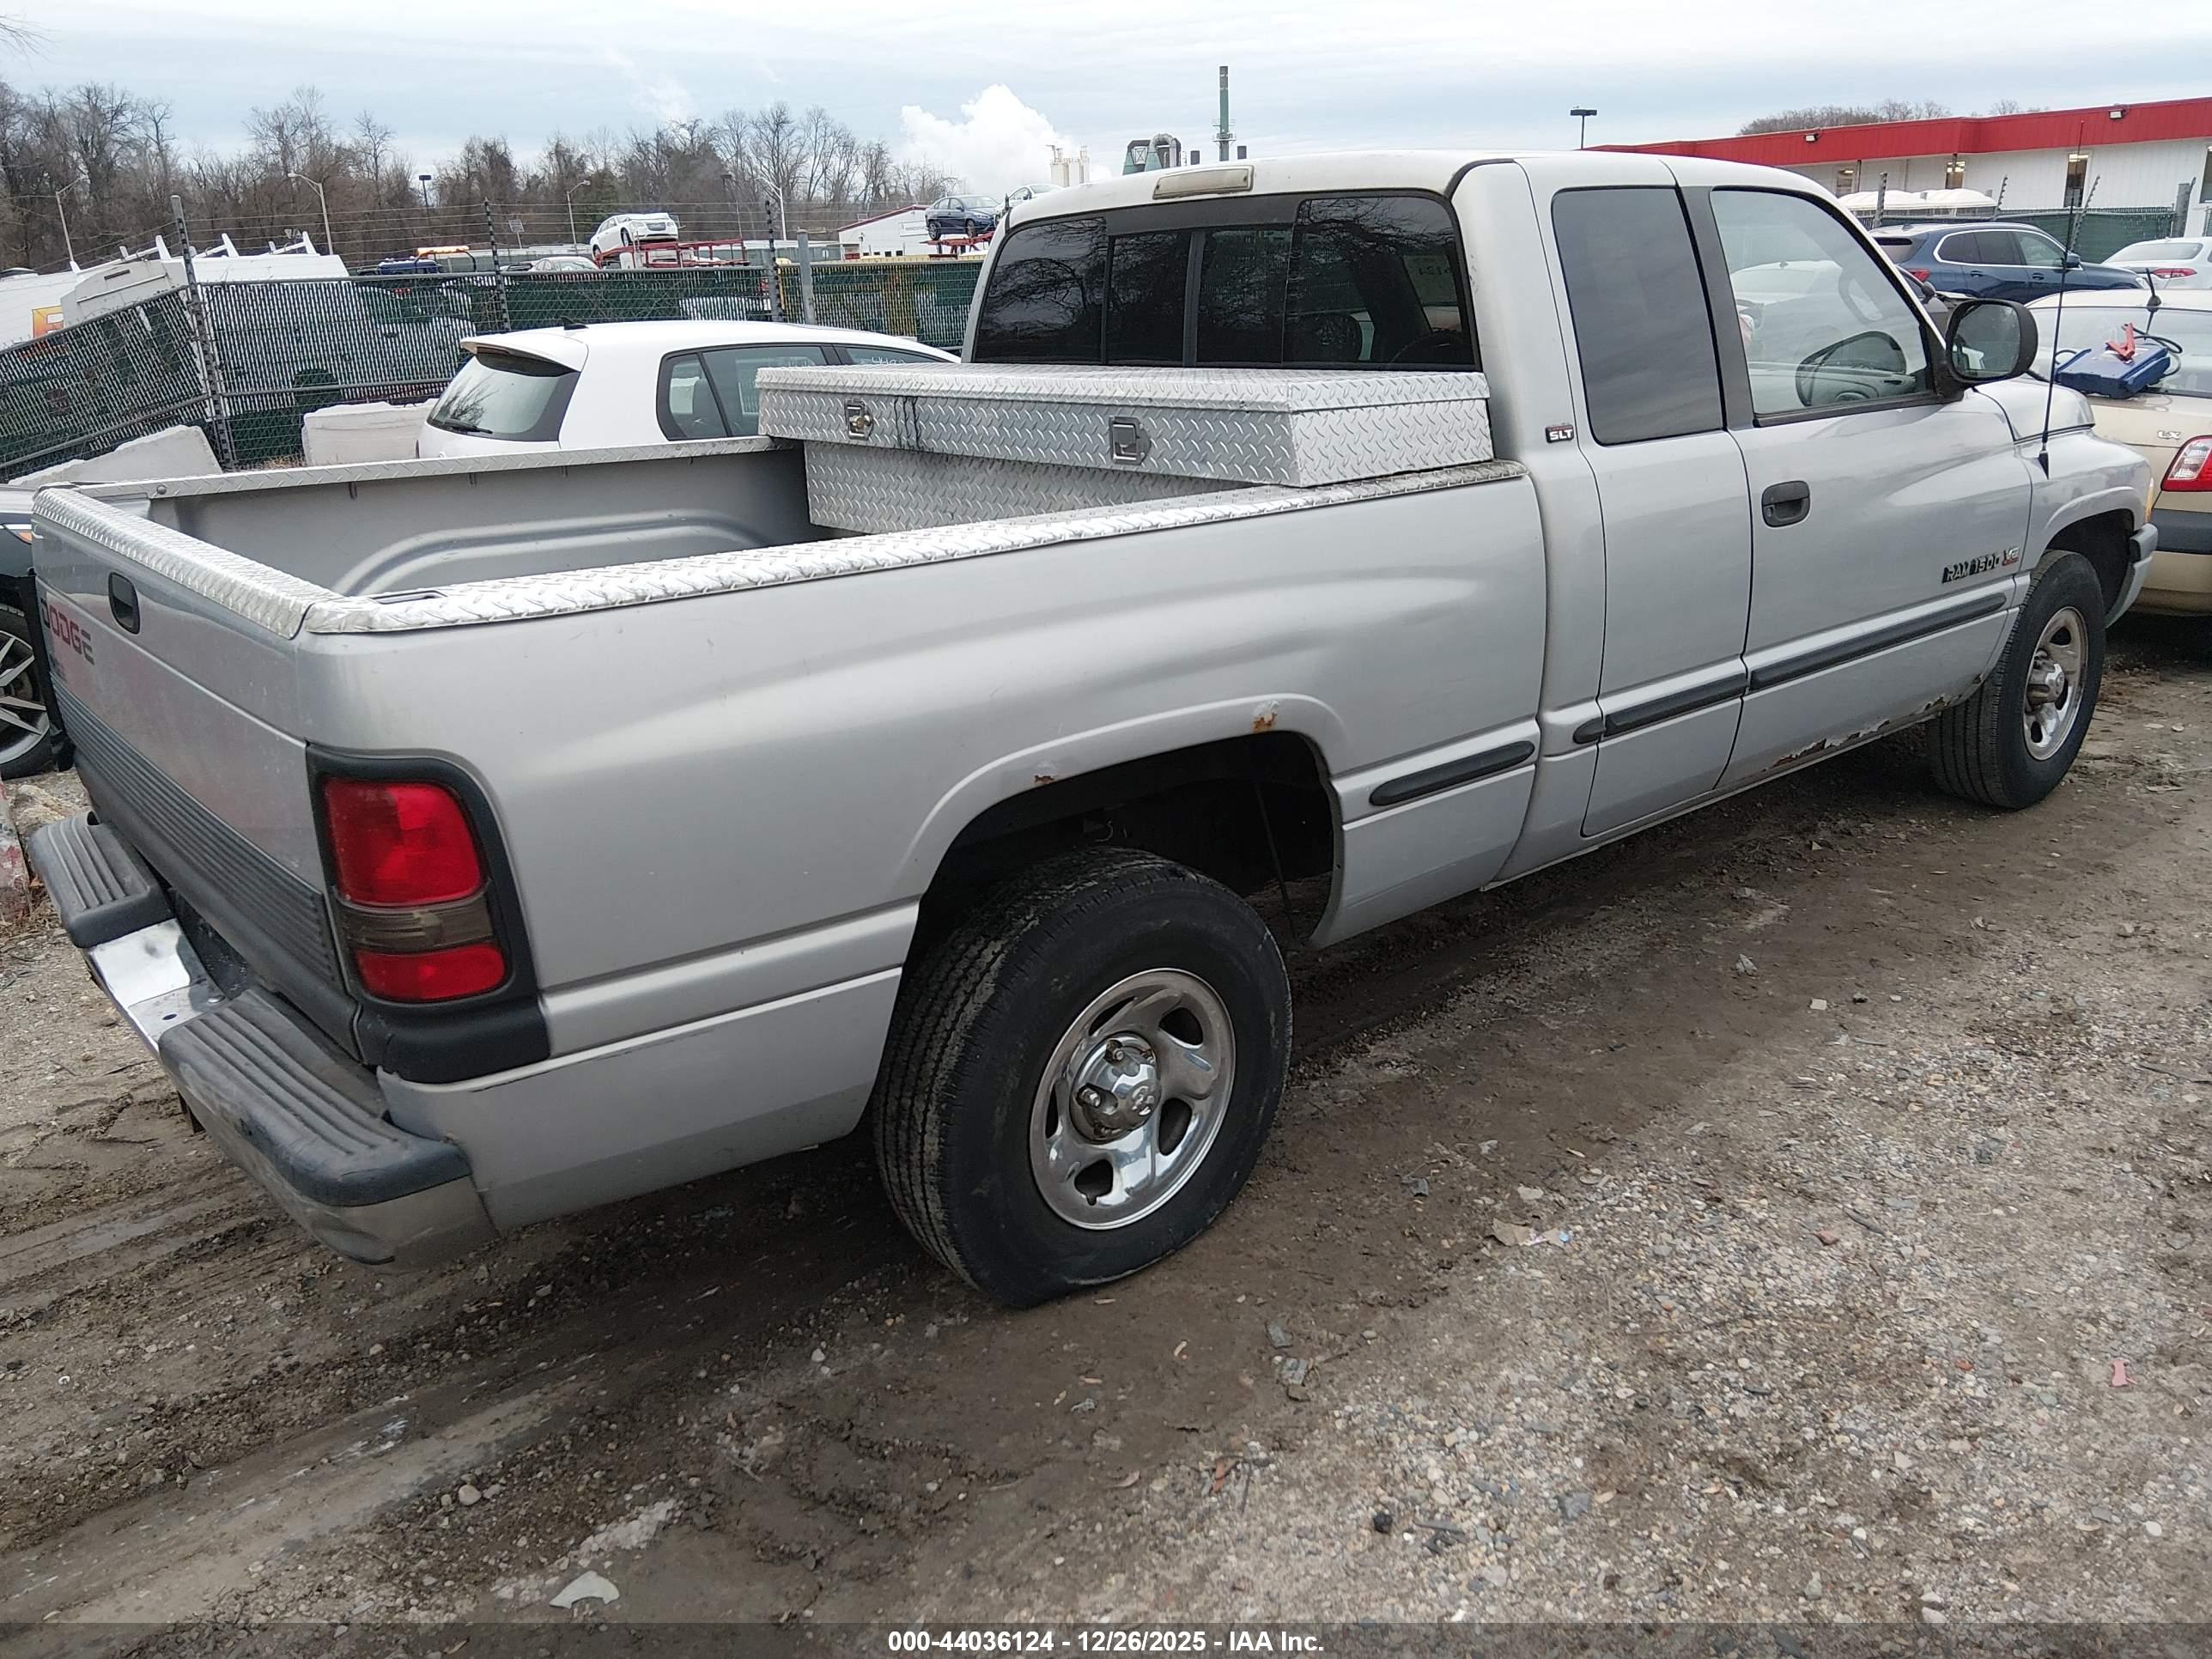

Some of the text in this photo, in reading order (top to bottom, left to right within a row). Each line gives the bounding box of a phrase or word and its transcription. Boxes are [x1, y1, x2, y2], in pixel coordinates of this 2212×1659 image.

[1549, 428, 1572, 441] SLT
[2157, 430, 2181, 440] LX
[1942, 561, 1970, 583] RAM
[1970, 553, 2002, 575] 1500
[40, 598, 94, 665] DODGE
